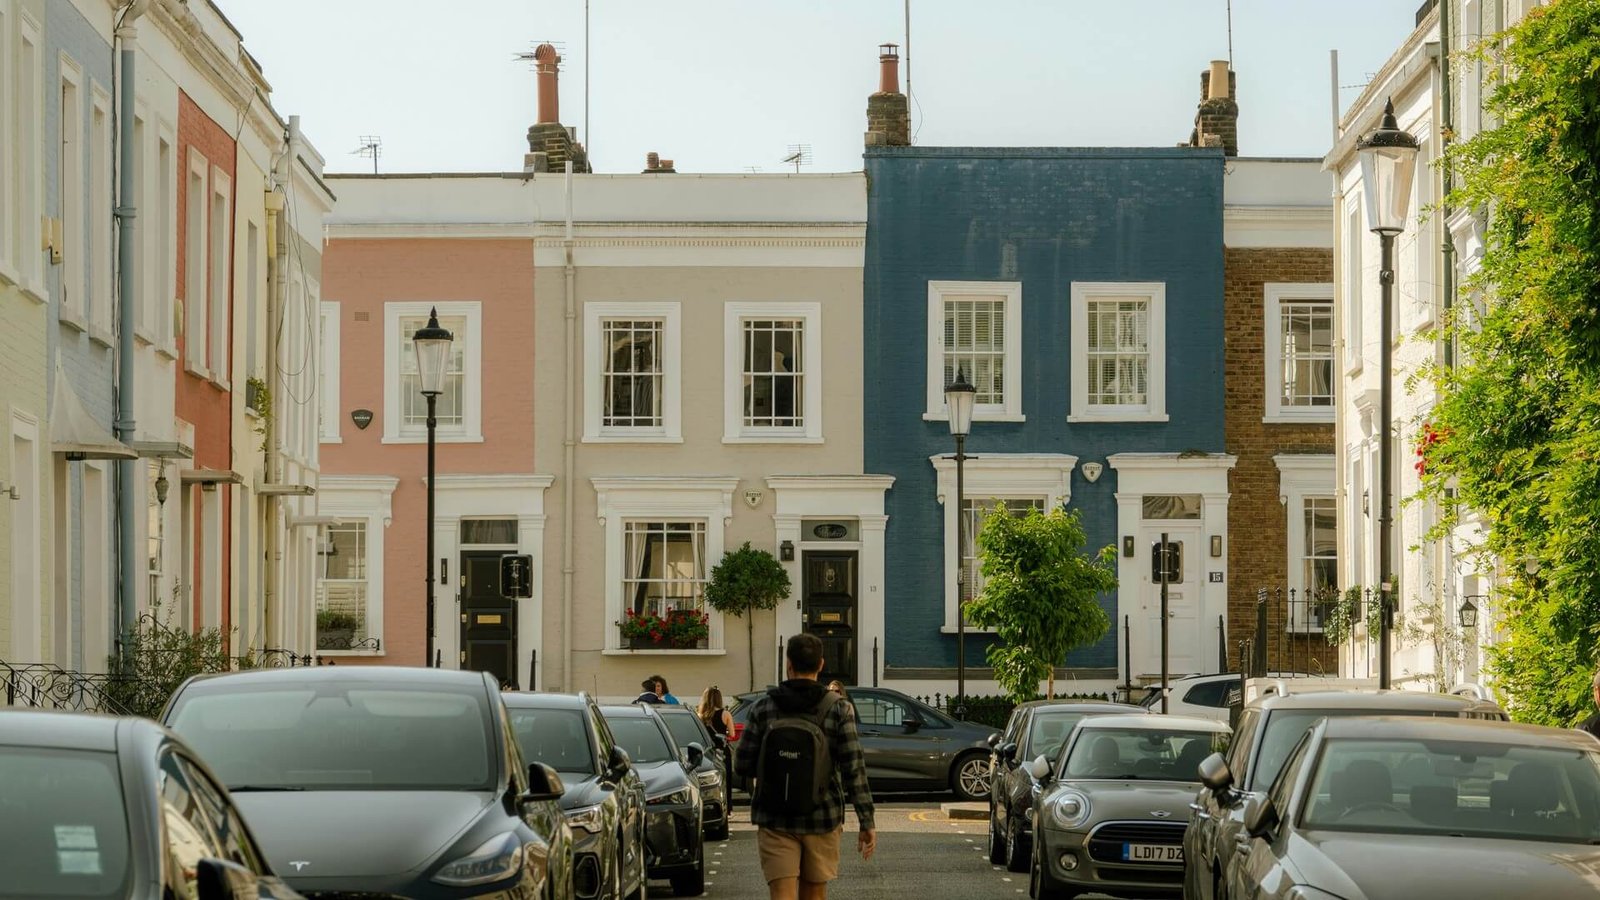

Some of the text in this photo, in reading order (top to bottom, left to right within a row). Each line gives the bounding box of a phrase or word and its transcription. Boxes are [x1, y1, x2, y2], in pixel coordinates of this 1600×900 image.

[1212, 572, 1221, 582] 15
[1134, 846, 1184, 860] LD17 DZ
